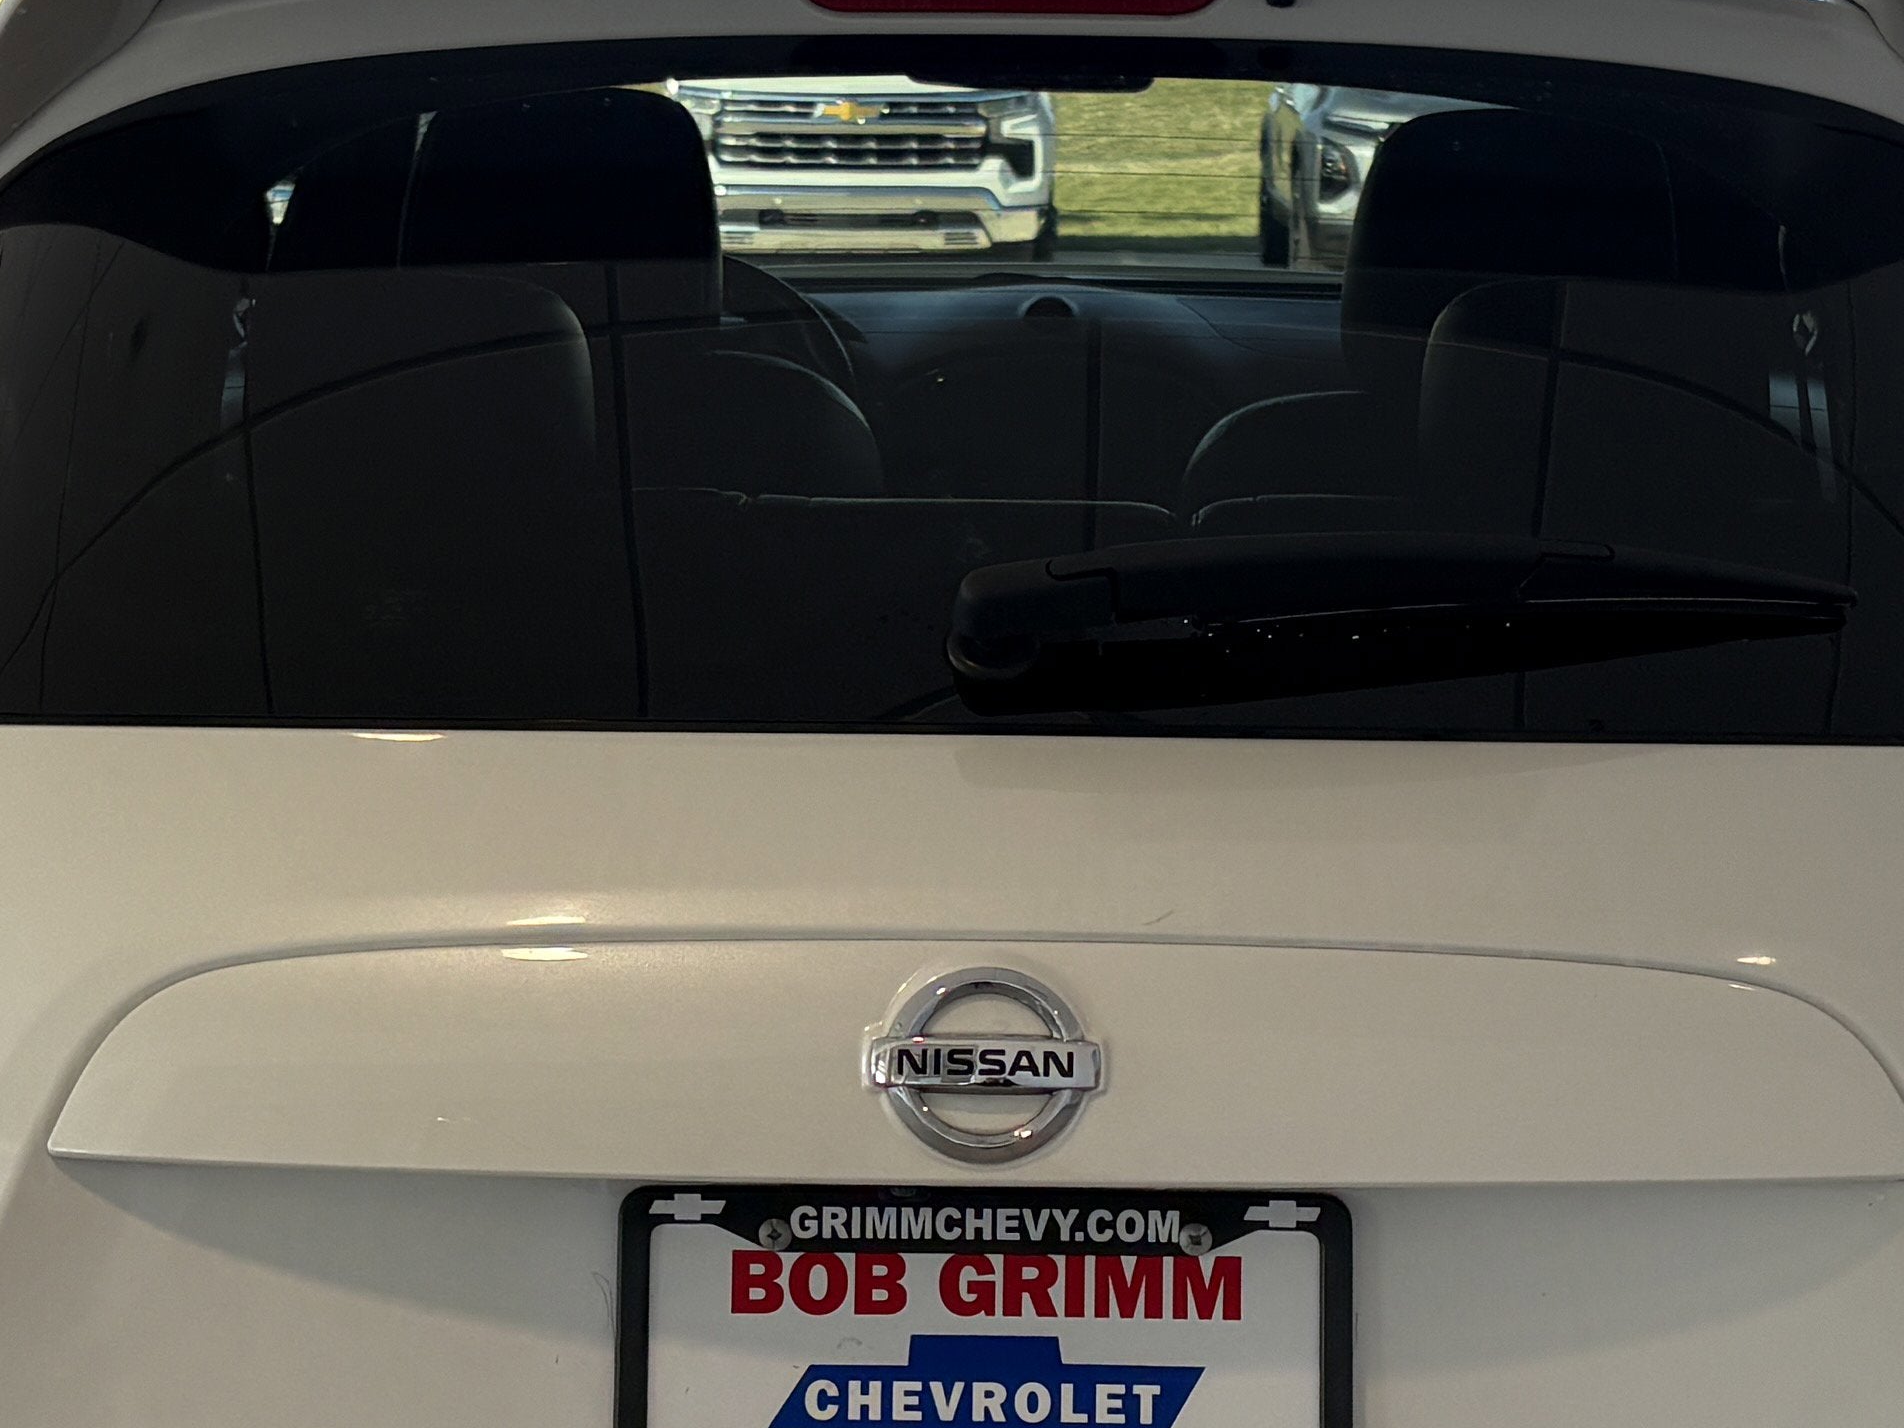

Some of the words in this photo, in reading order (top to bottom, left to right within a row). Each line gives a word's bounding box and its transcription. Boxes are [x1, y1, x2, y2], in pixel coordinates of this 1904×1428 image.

[896, 1047, 1075, 1079] NISSAN
[788, 1205, 1182, 1246] GRIMMCHEVY.COM
[731, 1249, 908, 1316] BOB
[938, 1254, 1243, 1321] GRIMM
[803, 1378, 1164, 1426] CHEVROLET
